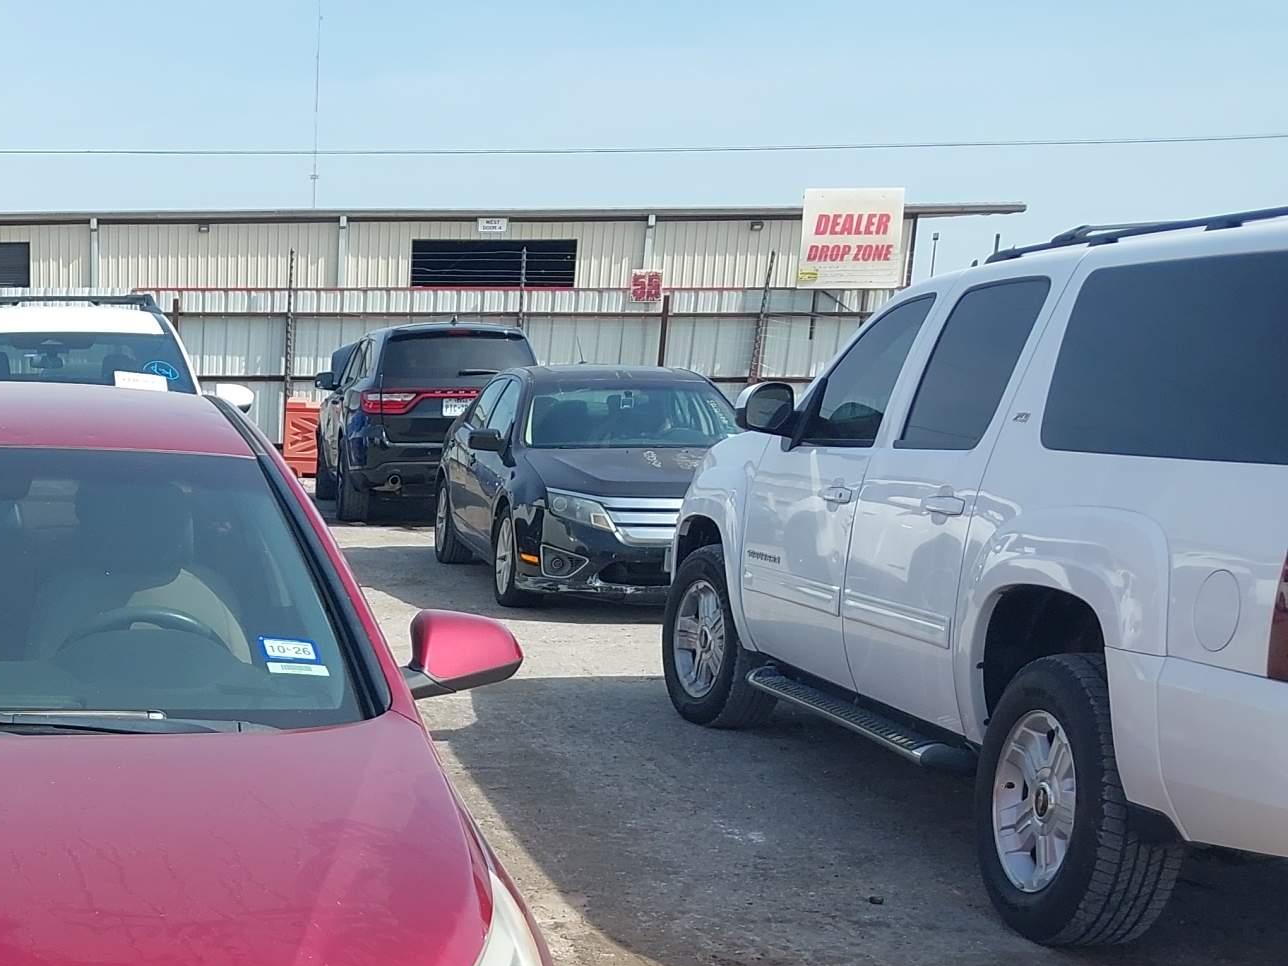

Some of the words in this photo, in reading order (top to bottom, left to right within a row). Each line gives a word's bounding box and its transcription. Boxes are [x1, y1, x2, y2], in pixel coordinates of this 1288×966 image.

[814, 213, 891, 235] DEALER
[807, 244, 852, 262] DROP
[852, 244, 894, 261] ZONE
